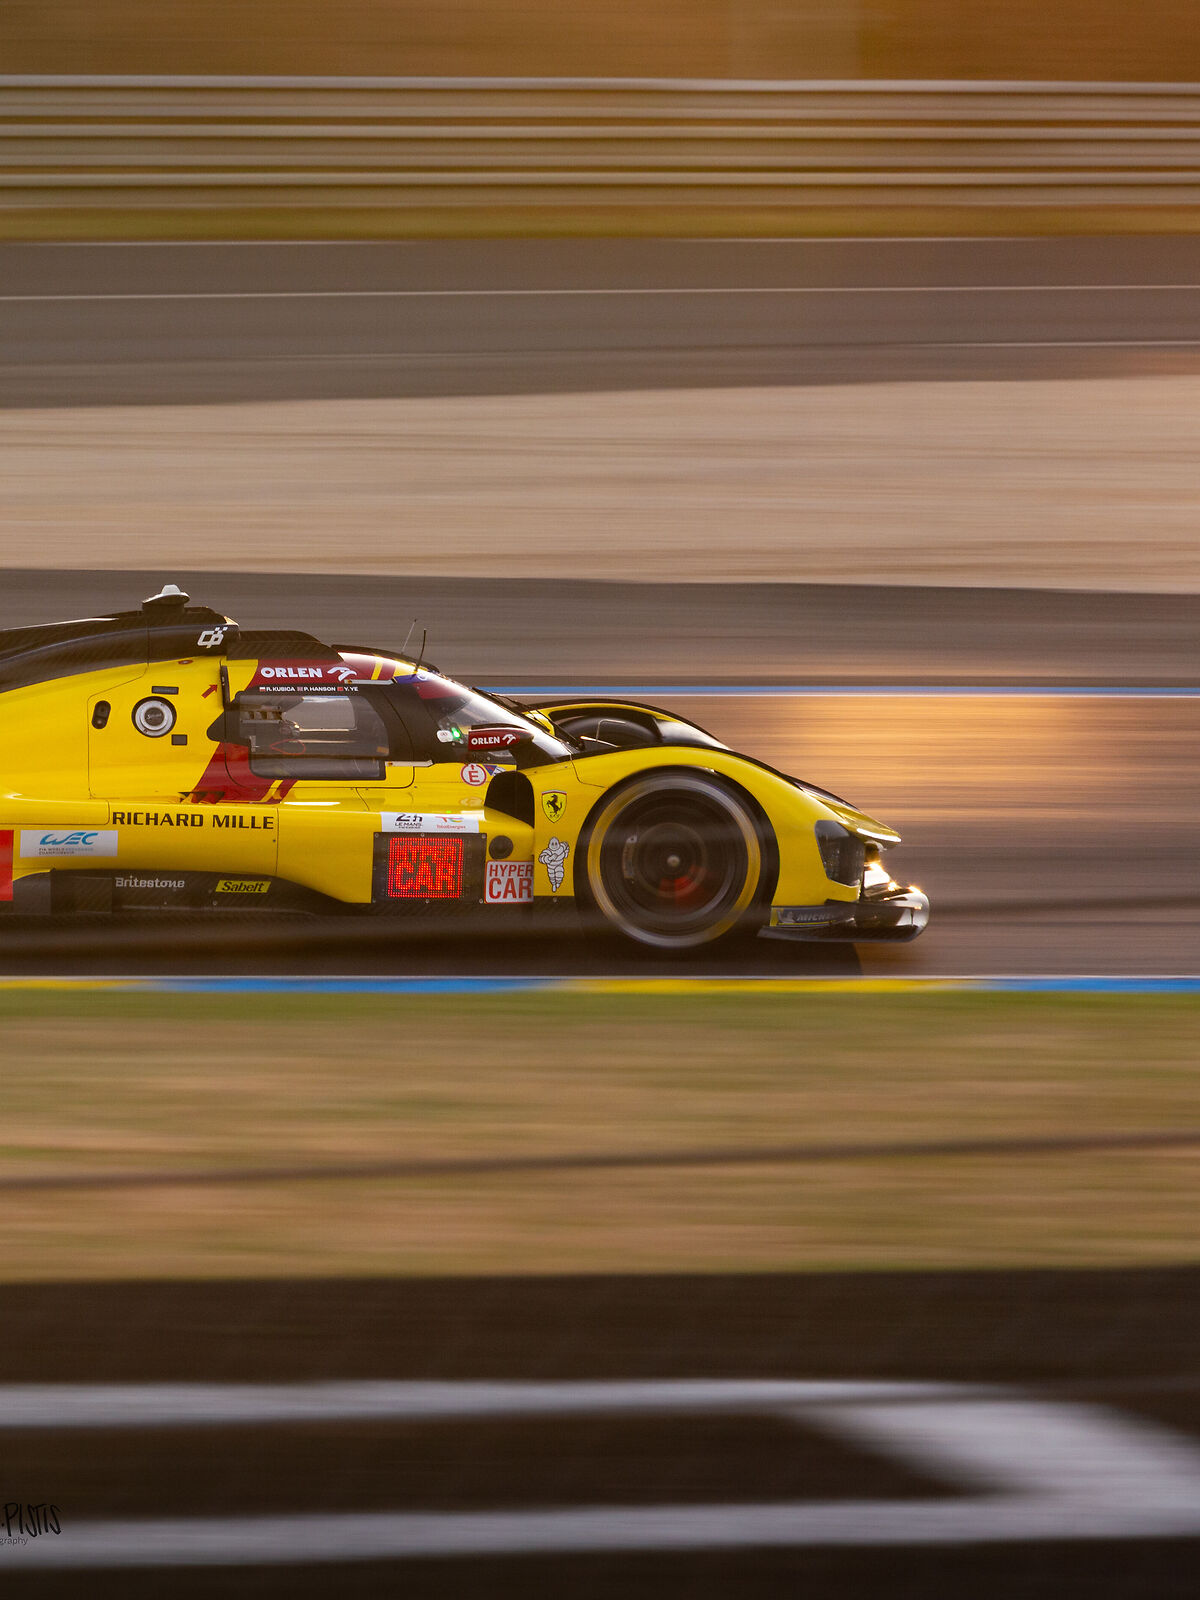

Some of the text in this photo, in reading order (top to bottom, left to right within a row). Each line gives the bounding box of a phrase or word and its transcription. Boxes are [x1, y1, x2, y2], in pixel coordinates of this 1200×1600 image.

[260, 666, 323, 678] ORLEN
[471, 736, 500, 745] ORLEN
[468, 770, 480, 783] E
[112, 811, 275, 830] RICHARD MILLE
[40, 832, 98, 846] WEC
[395, 861, 457, 890] CAR
[489, 864, 534, 877] HYPER
[221, 881, 266, 892] Sabelt
[488, 877, 533, 899] CAR
